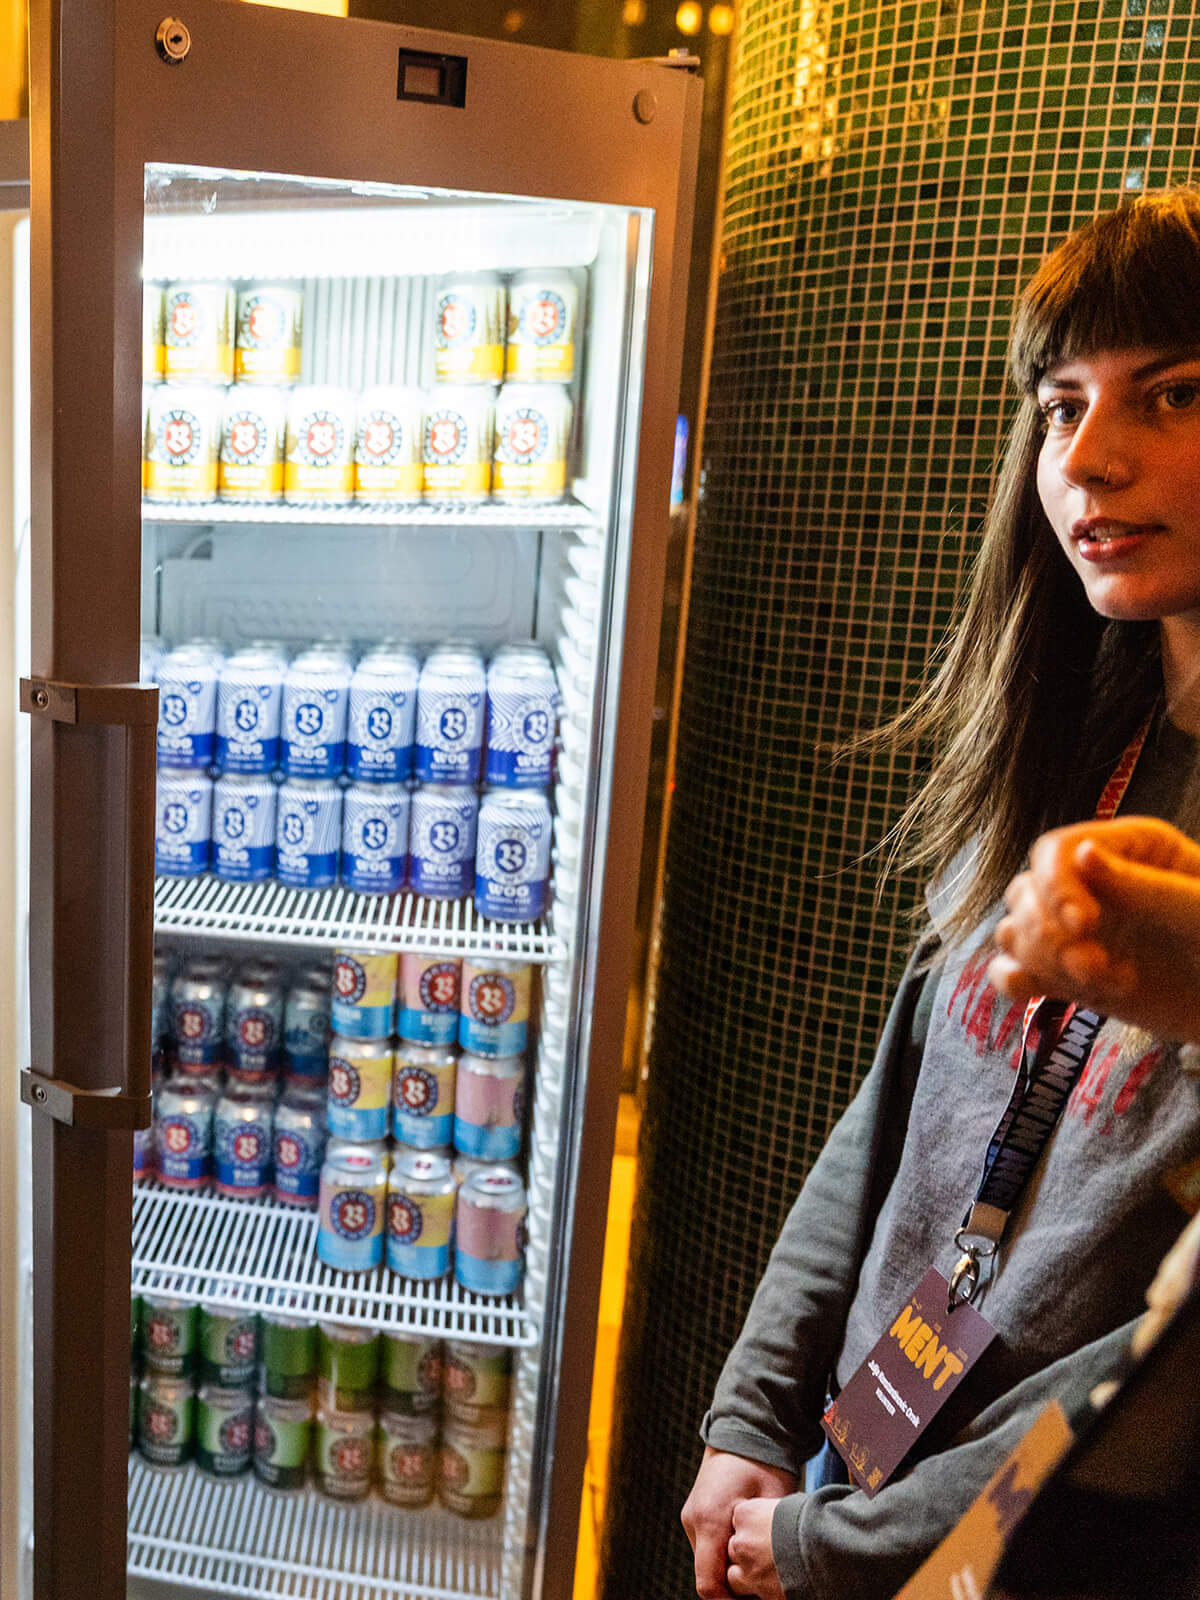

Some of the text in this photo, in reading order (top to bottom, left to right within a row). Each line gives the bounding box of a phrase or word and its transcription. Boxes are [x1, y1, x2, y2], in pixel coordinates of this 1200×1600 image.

[289, 746, 328, 759] WOO
[360, 749, 396, 763] WOO
[433, 750, 469, 764] WOO
[356, 859, 390, 873] WOO
[423, 861, 461, 876] WOO
[488, 881, 529, 897] WOO
[889, 1304, 963, 1390] MENT
